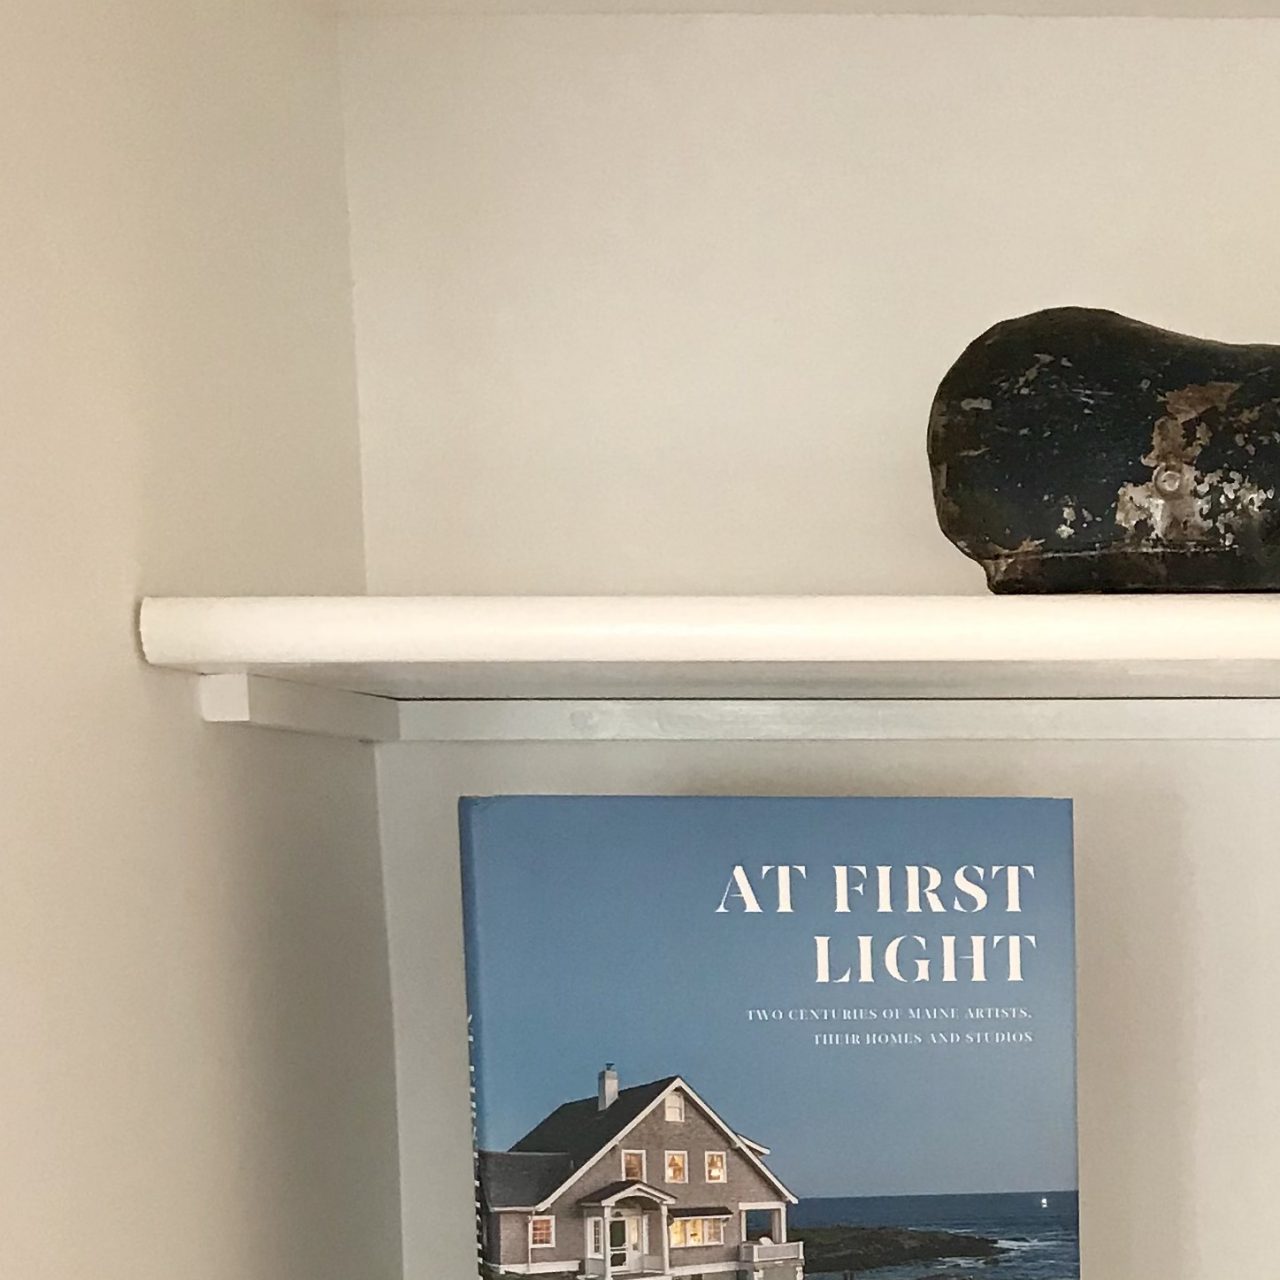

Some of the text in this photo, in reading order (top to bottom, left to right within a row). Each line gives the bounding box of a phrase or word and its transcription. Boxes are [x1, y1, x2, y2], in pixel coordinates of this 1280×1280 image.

[715, 864, 1036, 913] AT FIRST
[814, 935, 1037, 983] LIGHT
[748, 1008, 783, 1021] TWO
[788, 1008, 878, 1021] CENTURIES
[882, 1008, 901, 1020] OF
[908, 1007, 959, 1020] MAINE
[814, 1031, 1034, 1046] THEIR HOMES AND STUDIOS
